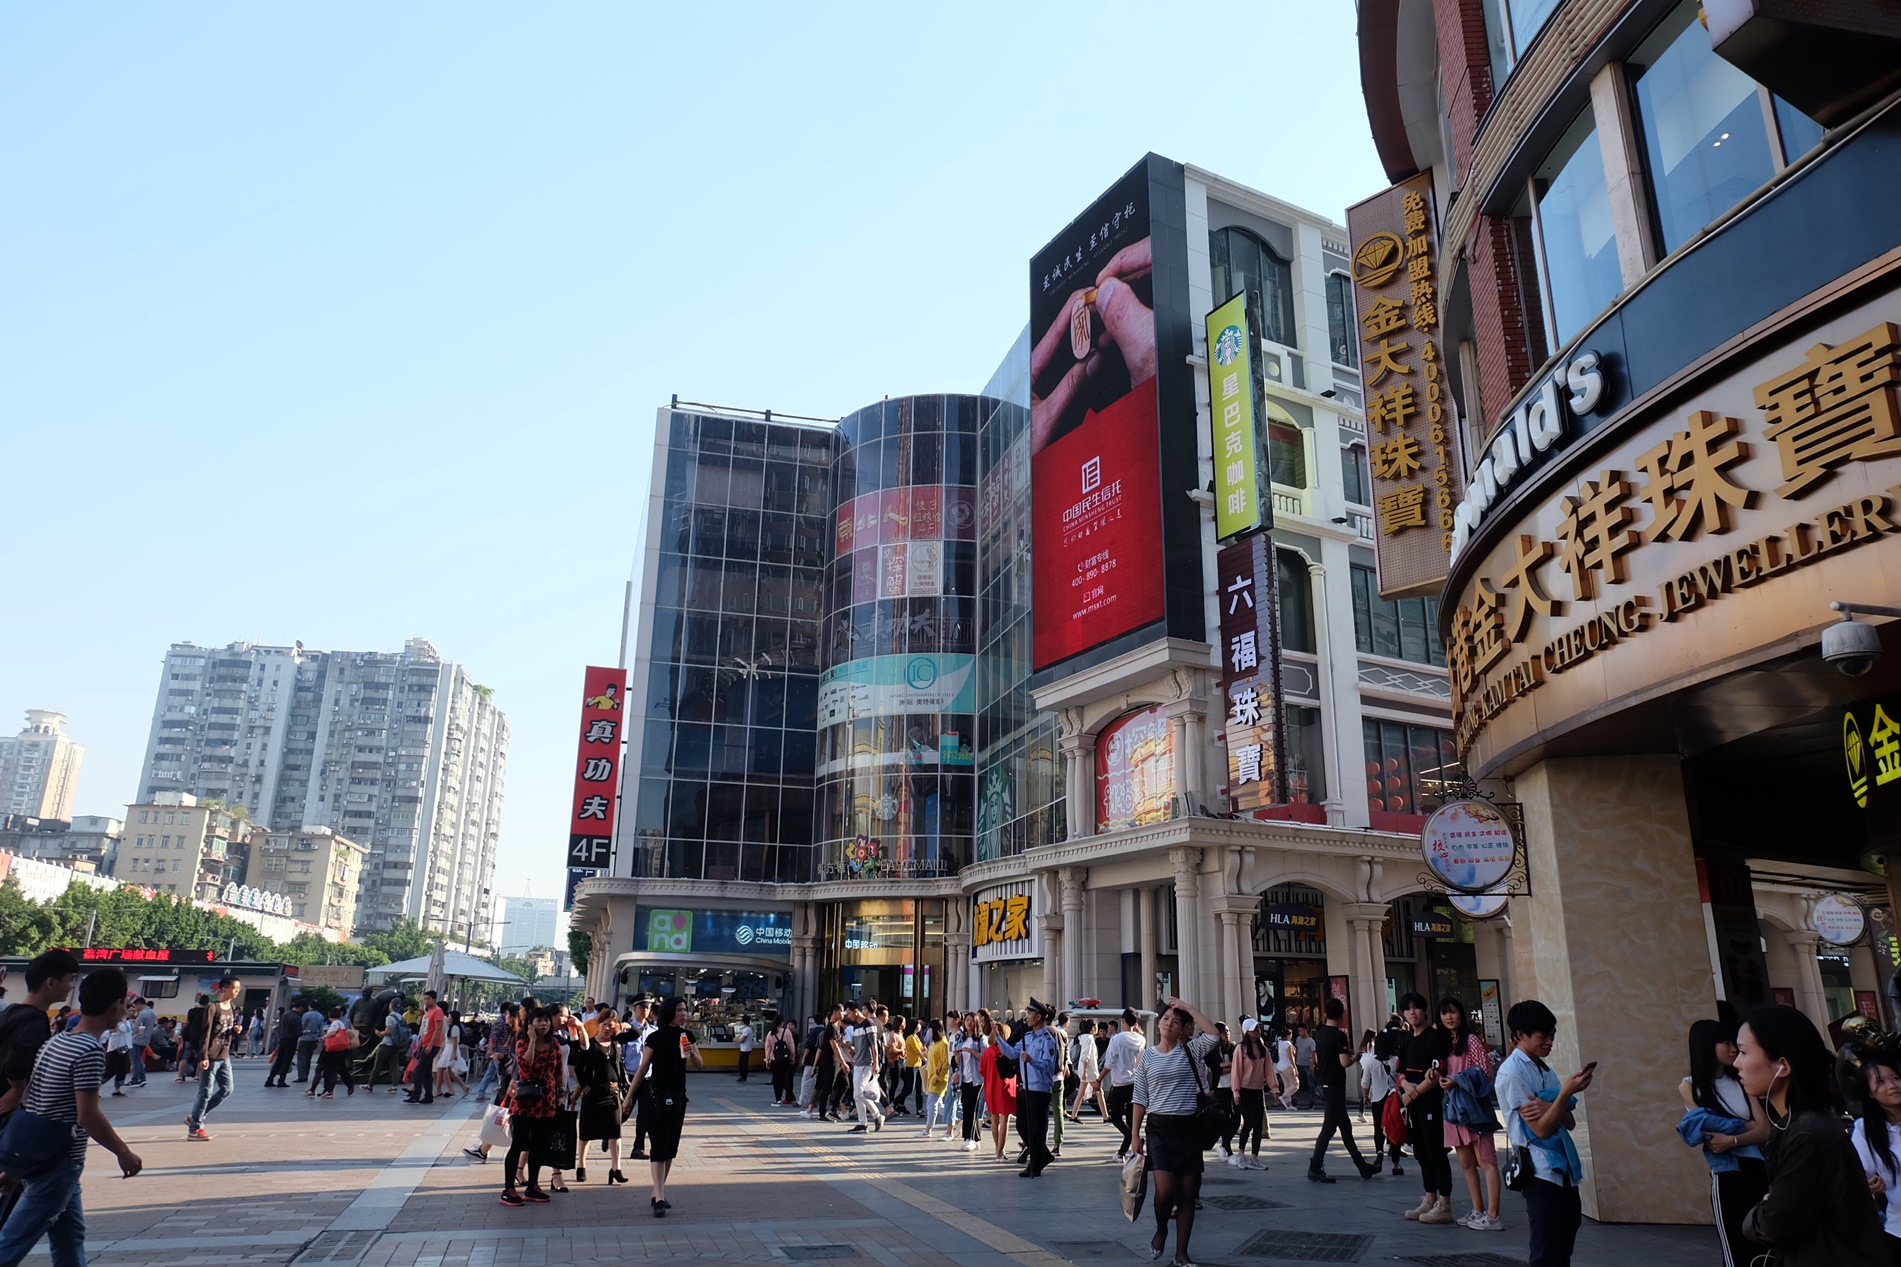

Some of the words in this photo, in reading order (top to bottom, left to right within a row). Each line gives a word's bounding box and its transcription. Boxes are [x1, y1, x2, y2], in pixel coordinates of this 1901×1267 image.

[1359, 294, 1426, 537] 金大祥珠寶
[1221, 371, 1247, 516] 星巴克咖啡
[1063, 479, 1122, 523] 中国民生信托
[1063, 517, 1079, 532] CHINA
[1078, 504, 1105, 524] MINSHENG
[1105, 496, 1122, 510] TRUST
[1541, 599, 1641, 674] CHEUNG
[1656, 486, 1901, 622] JEWELLER
[1072, 594, 1117, 620] www.msxt.com
[1227, 574, 1263, 786] 六福珠寶
[579, 720, 616, 820] 真功夫
[572, 837, 609, 862] 4F
[1270, 913, 1290, 925] HLA
[1291, 915, 1317, 926] 海澜之家
[1414, 922, 1431, 932] HLA
